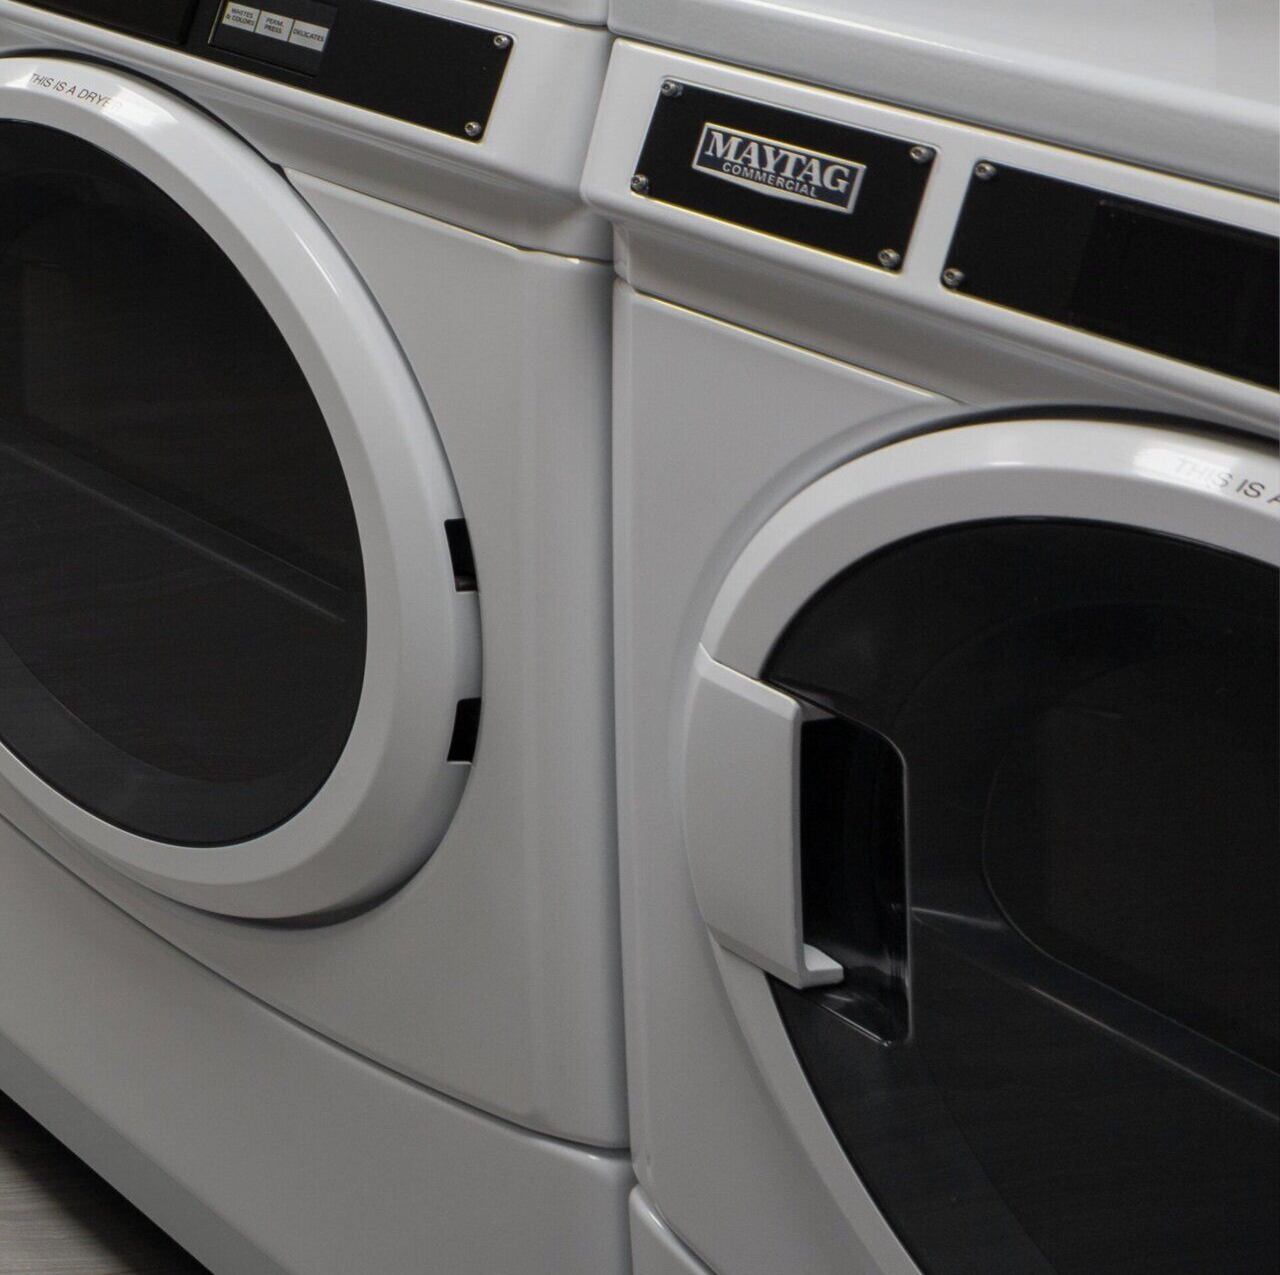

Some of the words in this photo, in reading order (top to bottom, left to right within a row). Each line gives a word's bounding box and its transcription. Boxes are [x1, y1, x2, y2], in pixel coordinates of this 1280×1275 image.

[231, 7, 254, 19] WHITES
[231, 15, 255, 27] COLORS
[264, 25, 282, 35] PRESS
[293, 28, 324, 42] DELICATES
[31, 73, 55, 88] THIS
[53, 80, 68, 92] IS
[65, 85, 77, 97] A
[76, 88, 122, 109] DRYE
[704, 130, 851, 194] MAYTAG
[722, 161, 818, 199] COMMERCIAL
[1236, 478, 1266, 498] IS
